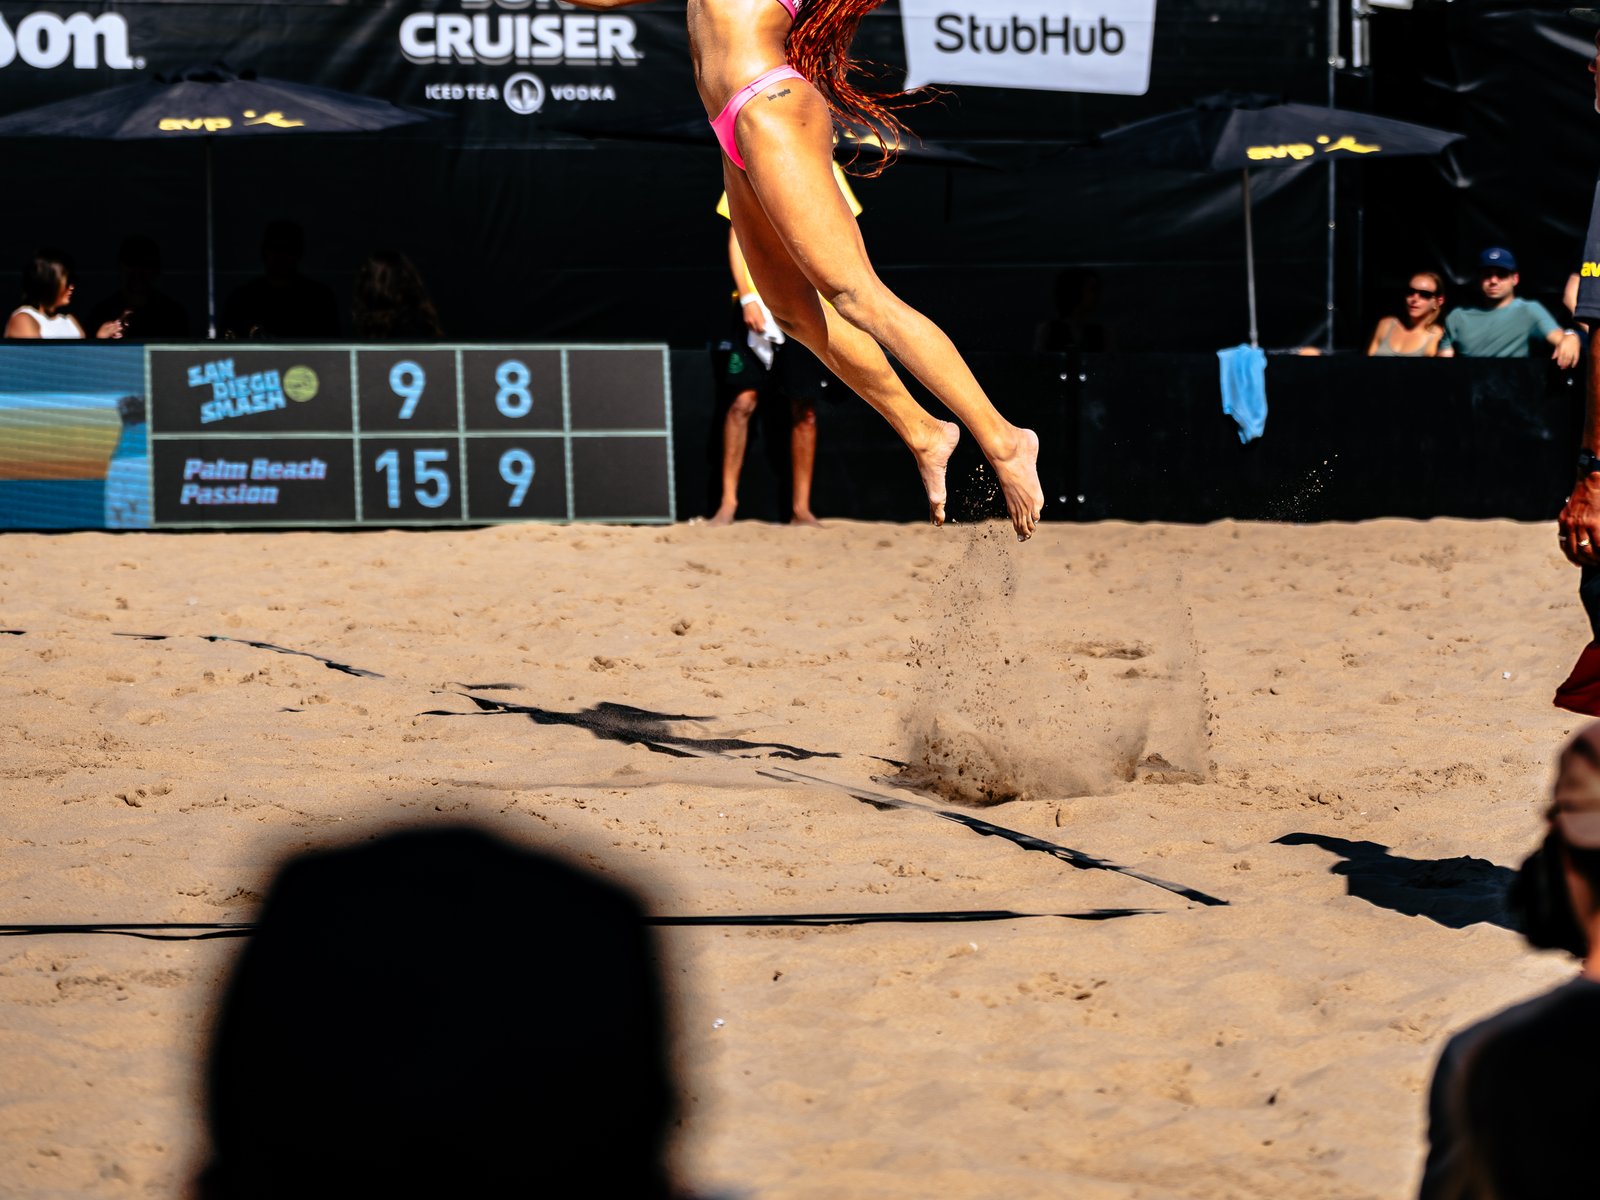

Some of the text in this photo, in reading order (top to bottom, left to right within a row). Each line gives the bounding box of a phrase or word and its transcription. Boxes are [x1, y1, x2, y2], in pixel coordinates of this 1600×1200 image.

[399, 12, 640, 66] CRUISER
[934, 13, 1126, 56] StubHub
[425, 83, 499, 100] ICED TEA
[550, 84, 616, 101] VODKA
[187, 358, 234, 388] SAN
[388, 359, 427, 420] 9
[495, 359, 534, 419] 8
[200, 390, 287, 424] SMASH
[183, 457, 328, 481] Palm Beach
[374, 448, 451, 509] 15
[498, 448, 536, 508] 9
[180, 482, 280, 505] Passion
